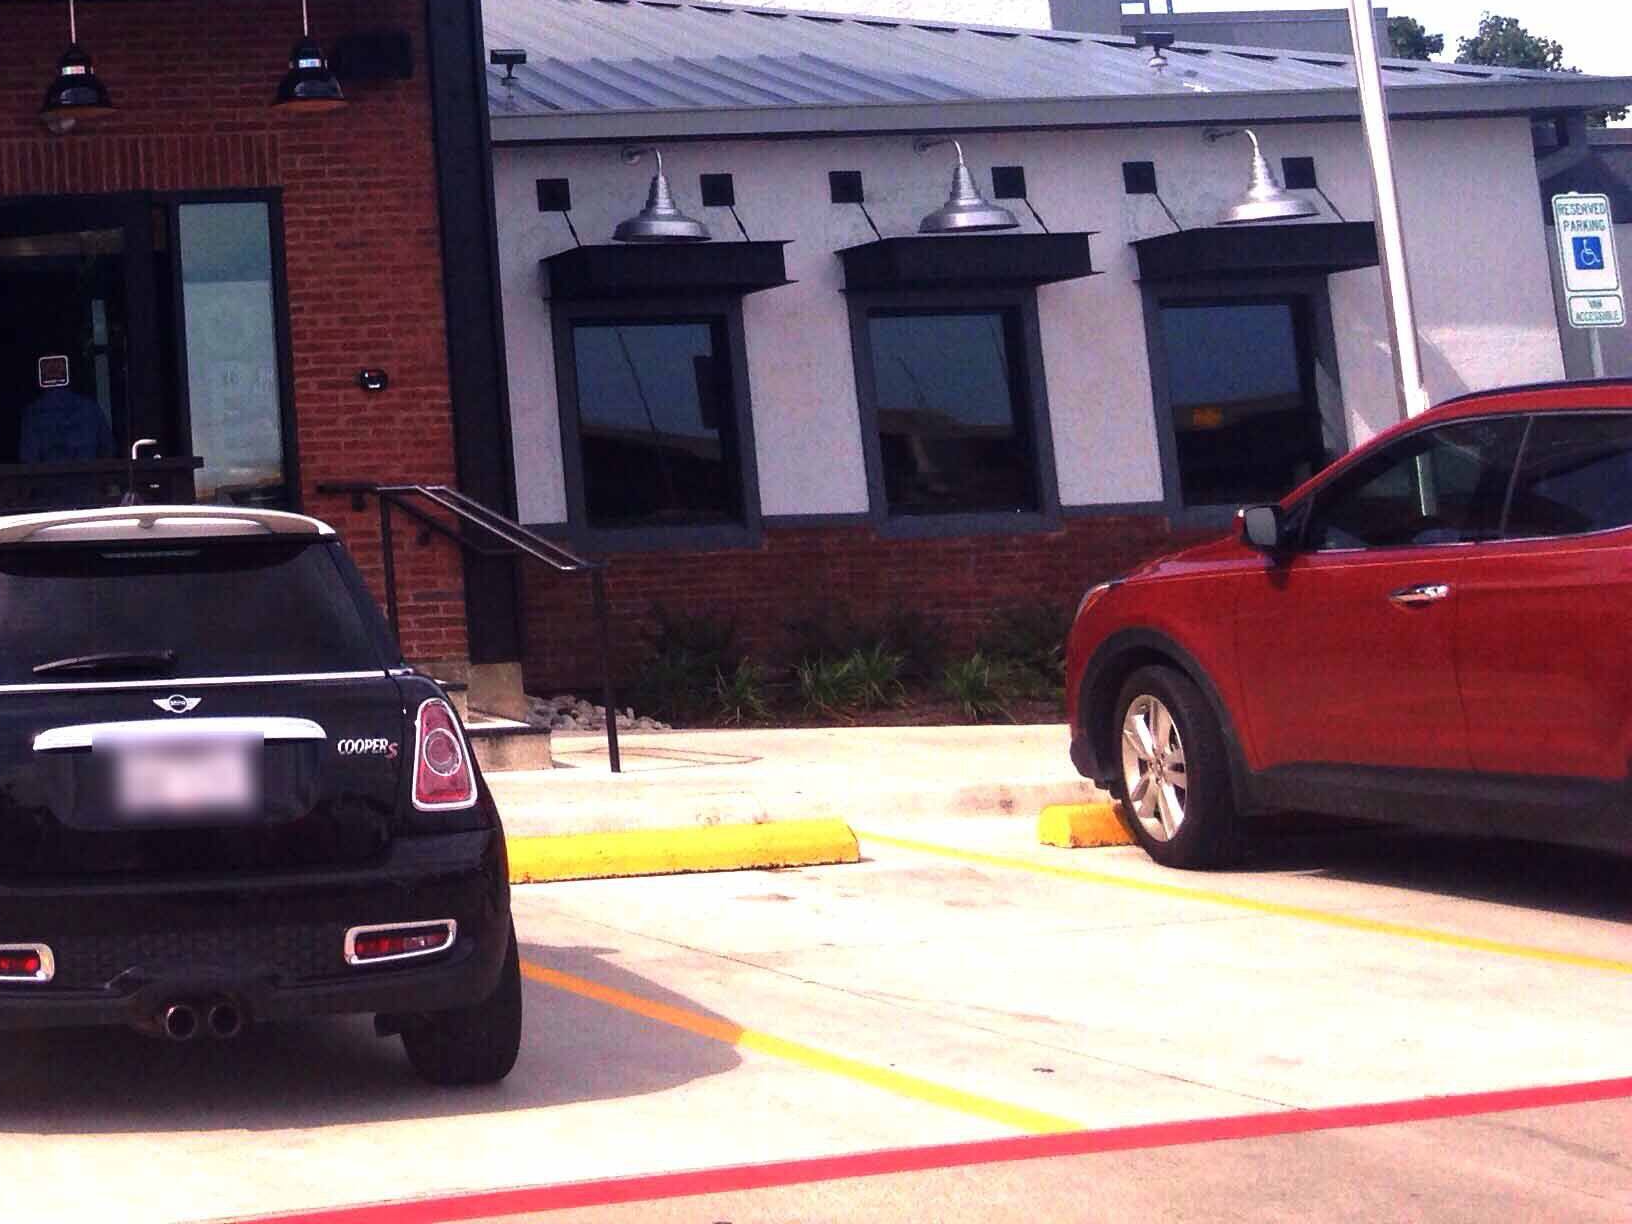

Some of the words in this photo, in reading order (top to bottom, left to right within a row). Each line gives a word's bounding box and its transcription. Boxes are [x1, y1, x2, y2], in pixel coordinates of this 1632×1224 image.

[1557, 202, 1607, 216] RESERVED
[1562, 219, 1607, 232] PARKING
[337, 738, 388, 755] COOPER
